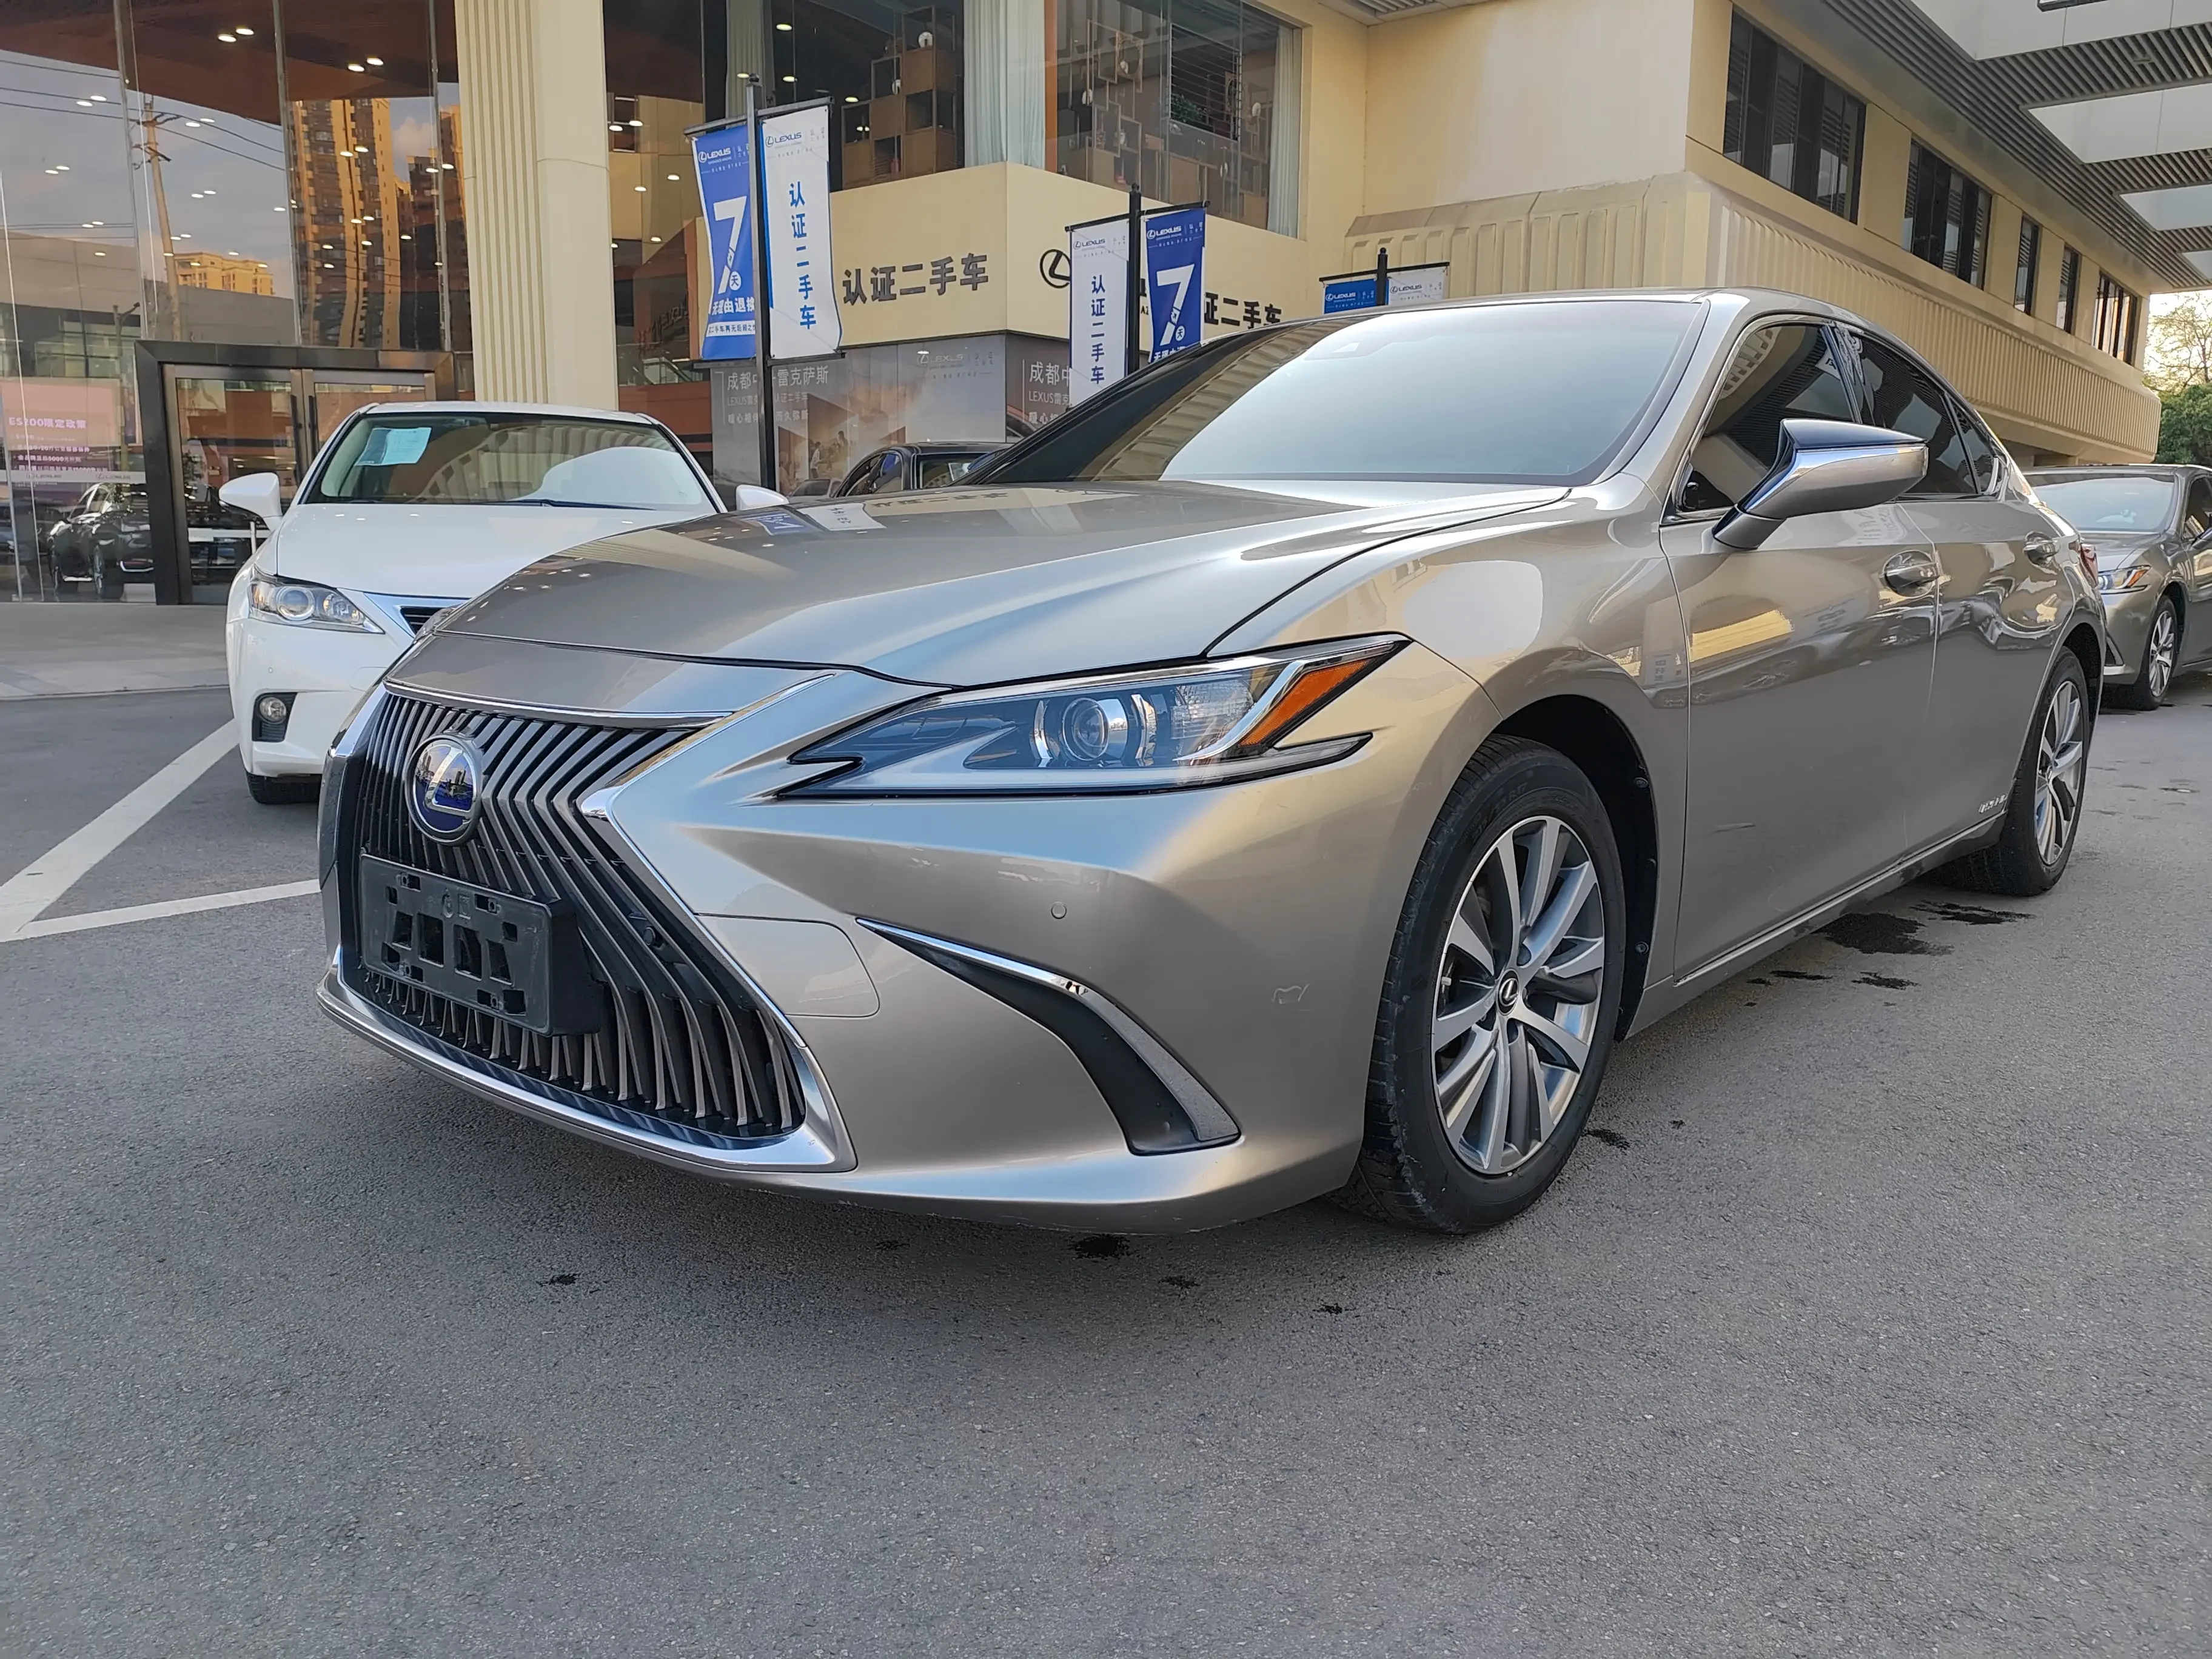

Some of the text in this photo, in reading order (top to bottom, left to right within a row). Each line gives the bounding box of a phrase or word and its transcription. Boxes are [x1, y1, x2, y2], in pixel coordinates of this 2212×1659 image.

[707, 147, 731, 159] LEXUS
[774, 132, 802, 144] LEXUS
[713, 196, 747, 294] 7
[1082, 238, 1105, 247] LEXUS
[1156, 226, 1182, 236] LEXUS
[789, 181, 817, 330] 认证二手车
[842, 253, 988, 306] 认证二手车
[1398, 284, 1423, 292] LEXUS
[1156, 263, 1195, 346] 7
[1204, 292, 1282, 329] 证二手车
[1090, 275, 1106, 384] 认证二手车
